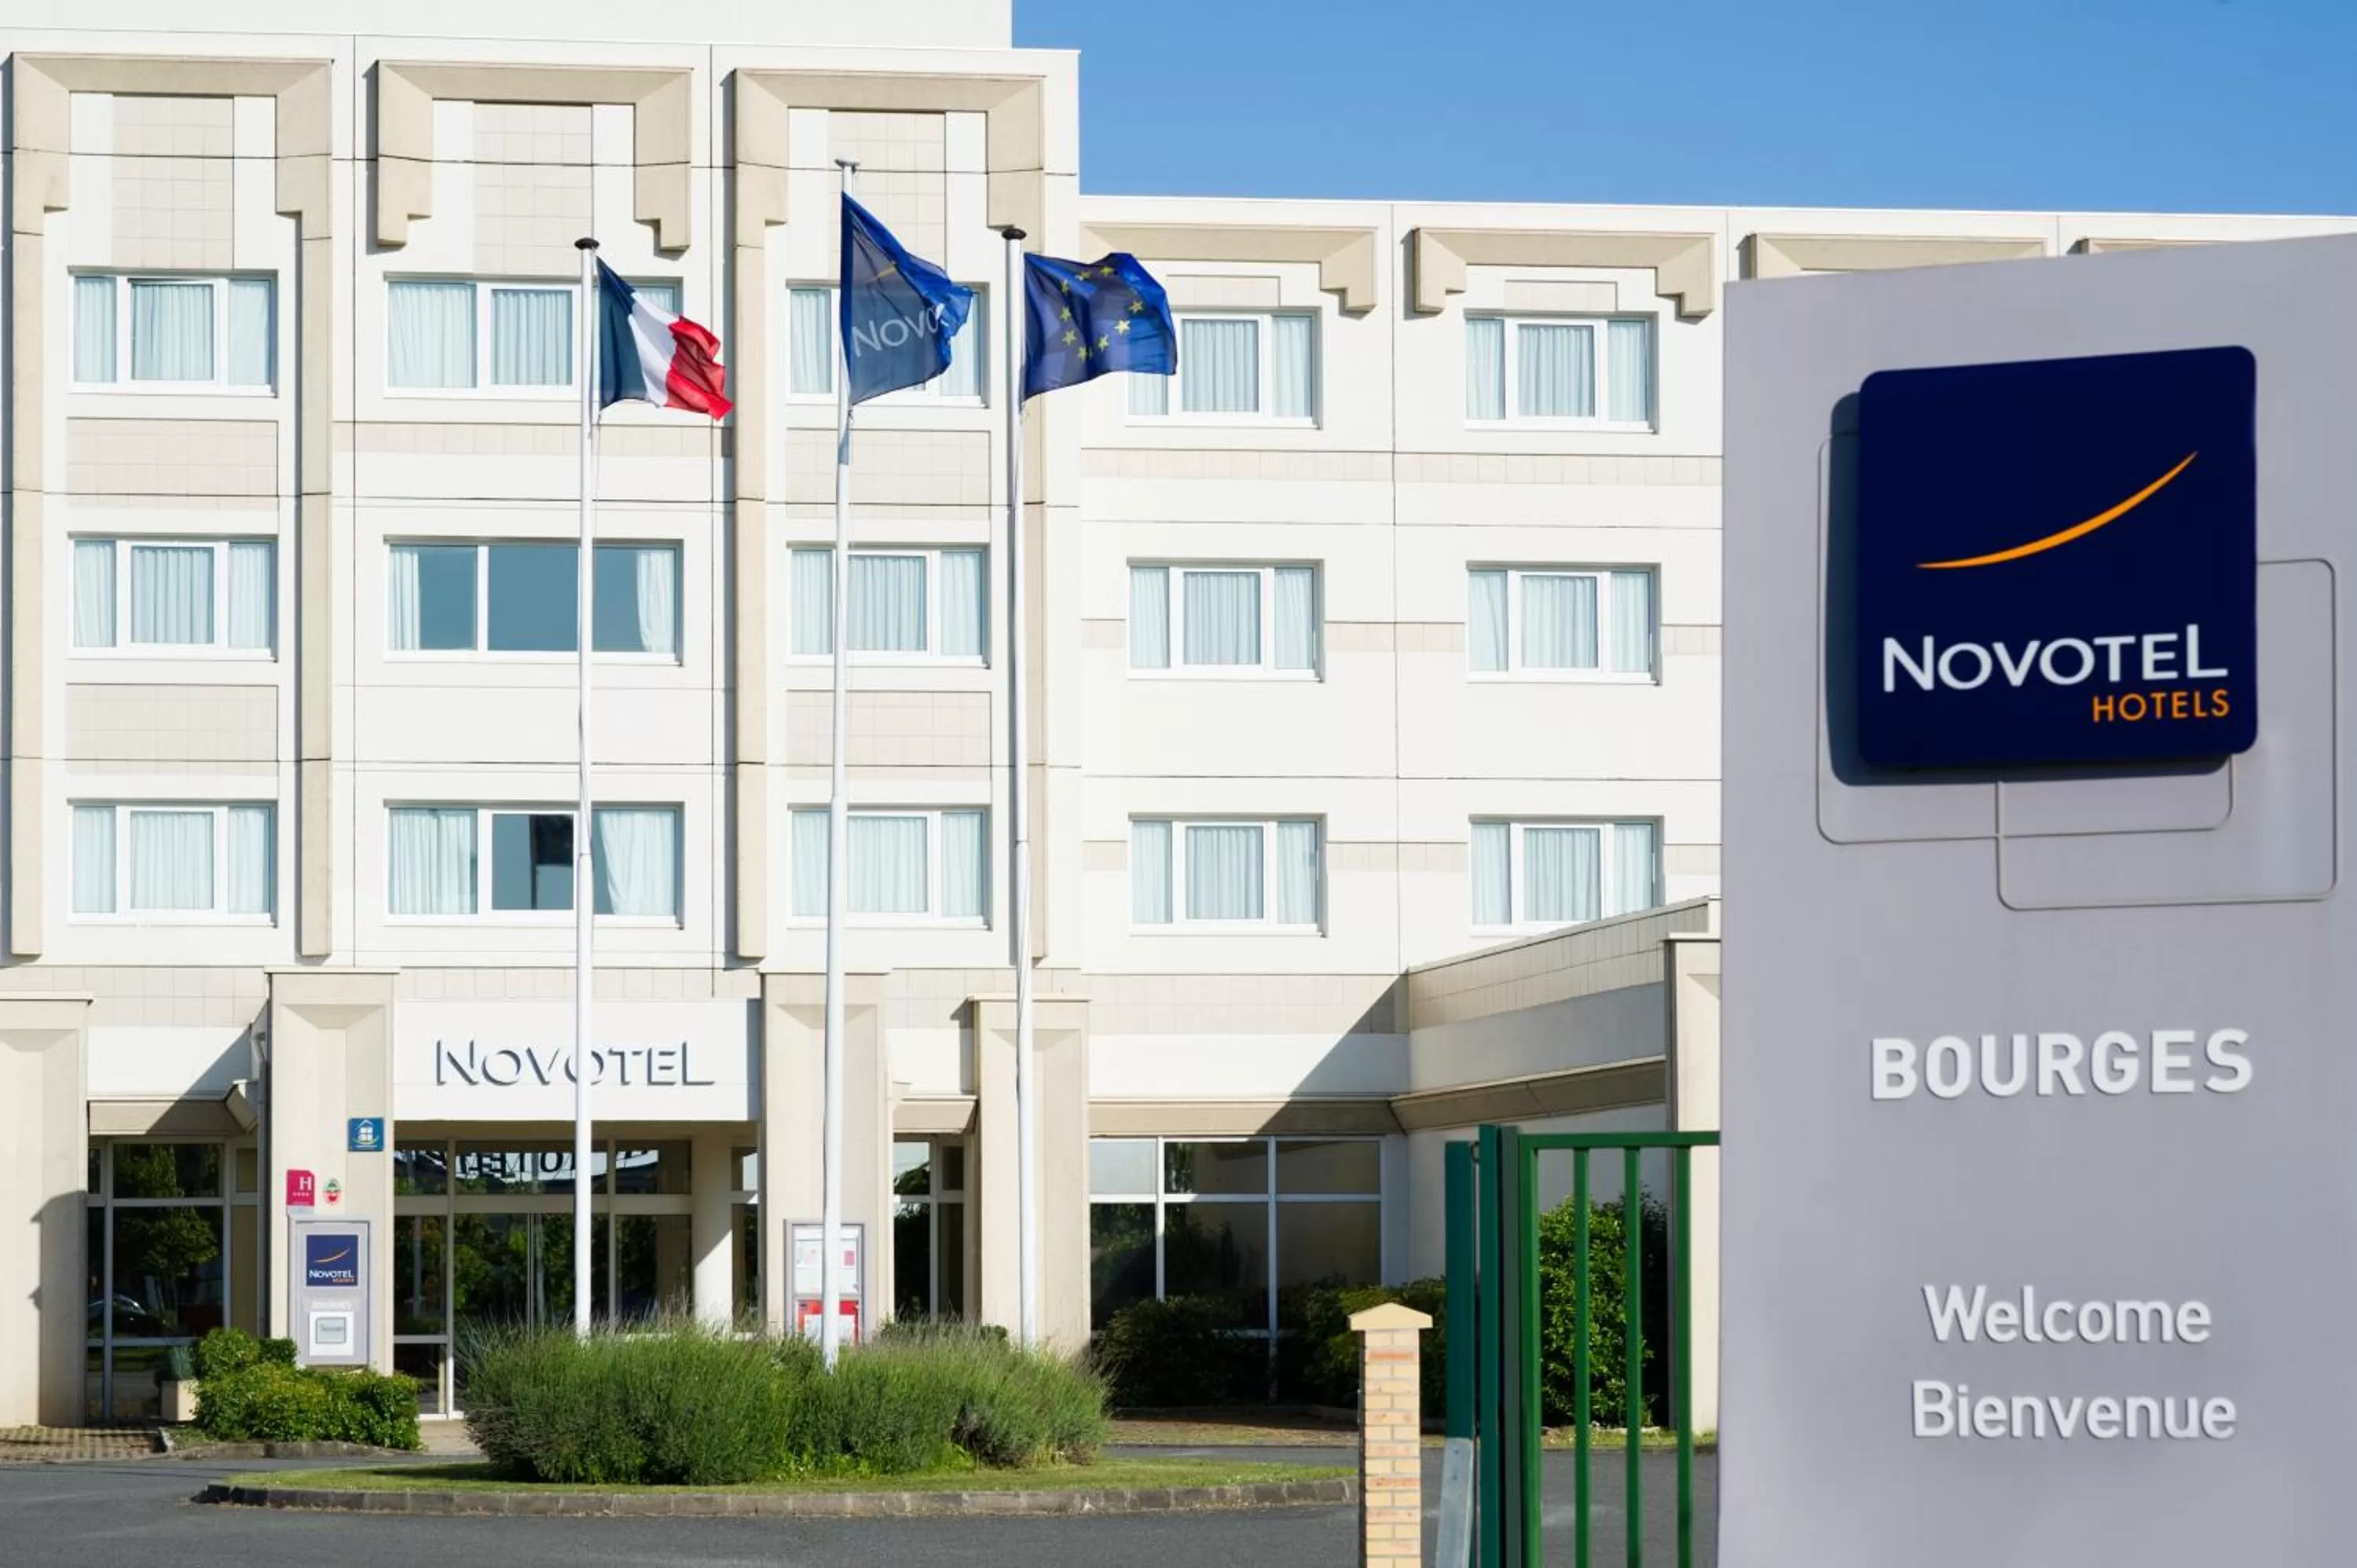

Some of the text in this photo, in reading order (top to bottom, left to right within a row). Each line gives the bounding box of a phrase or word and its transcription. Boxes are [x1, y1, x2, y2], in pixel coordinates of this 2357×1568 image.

[852, 303, 945, 357] NOVO
[1883, 624, 2228, 692] NOVOTEL
[2092, 689, 2231, 722] HOTELS
[436, 1039, 716, 1086] NOVOTEL
[1871, 1028, 2253, 1100] BOURGES
[299, 1176, 312, 1191] H
[309, 1269, 355, 1278] NOVOTEL
[1922, 1284, 2212, 1343] Welcome
[1912, 1379, 2237, 1439] Bienvenue
